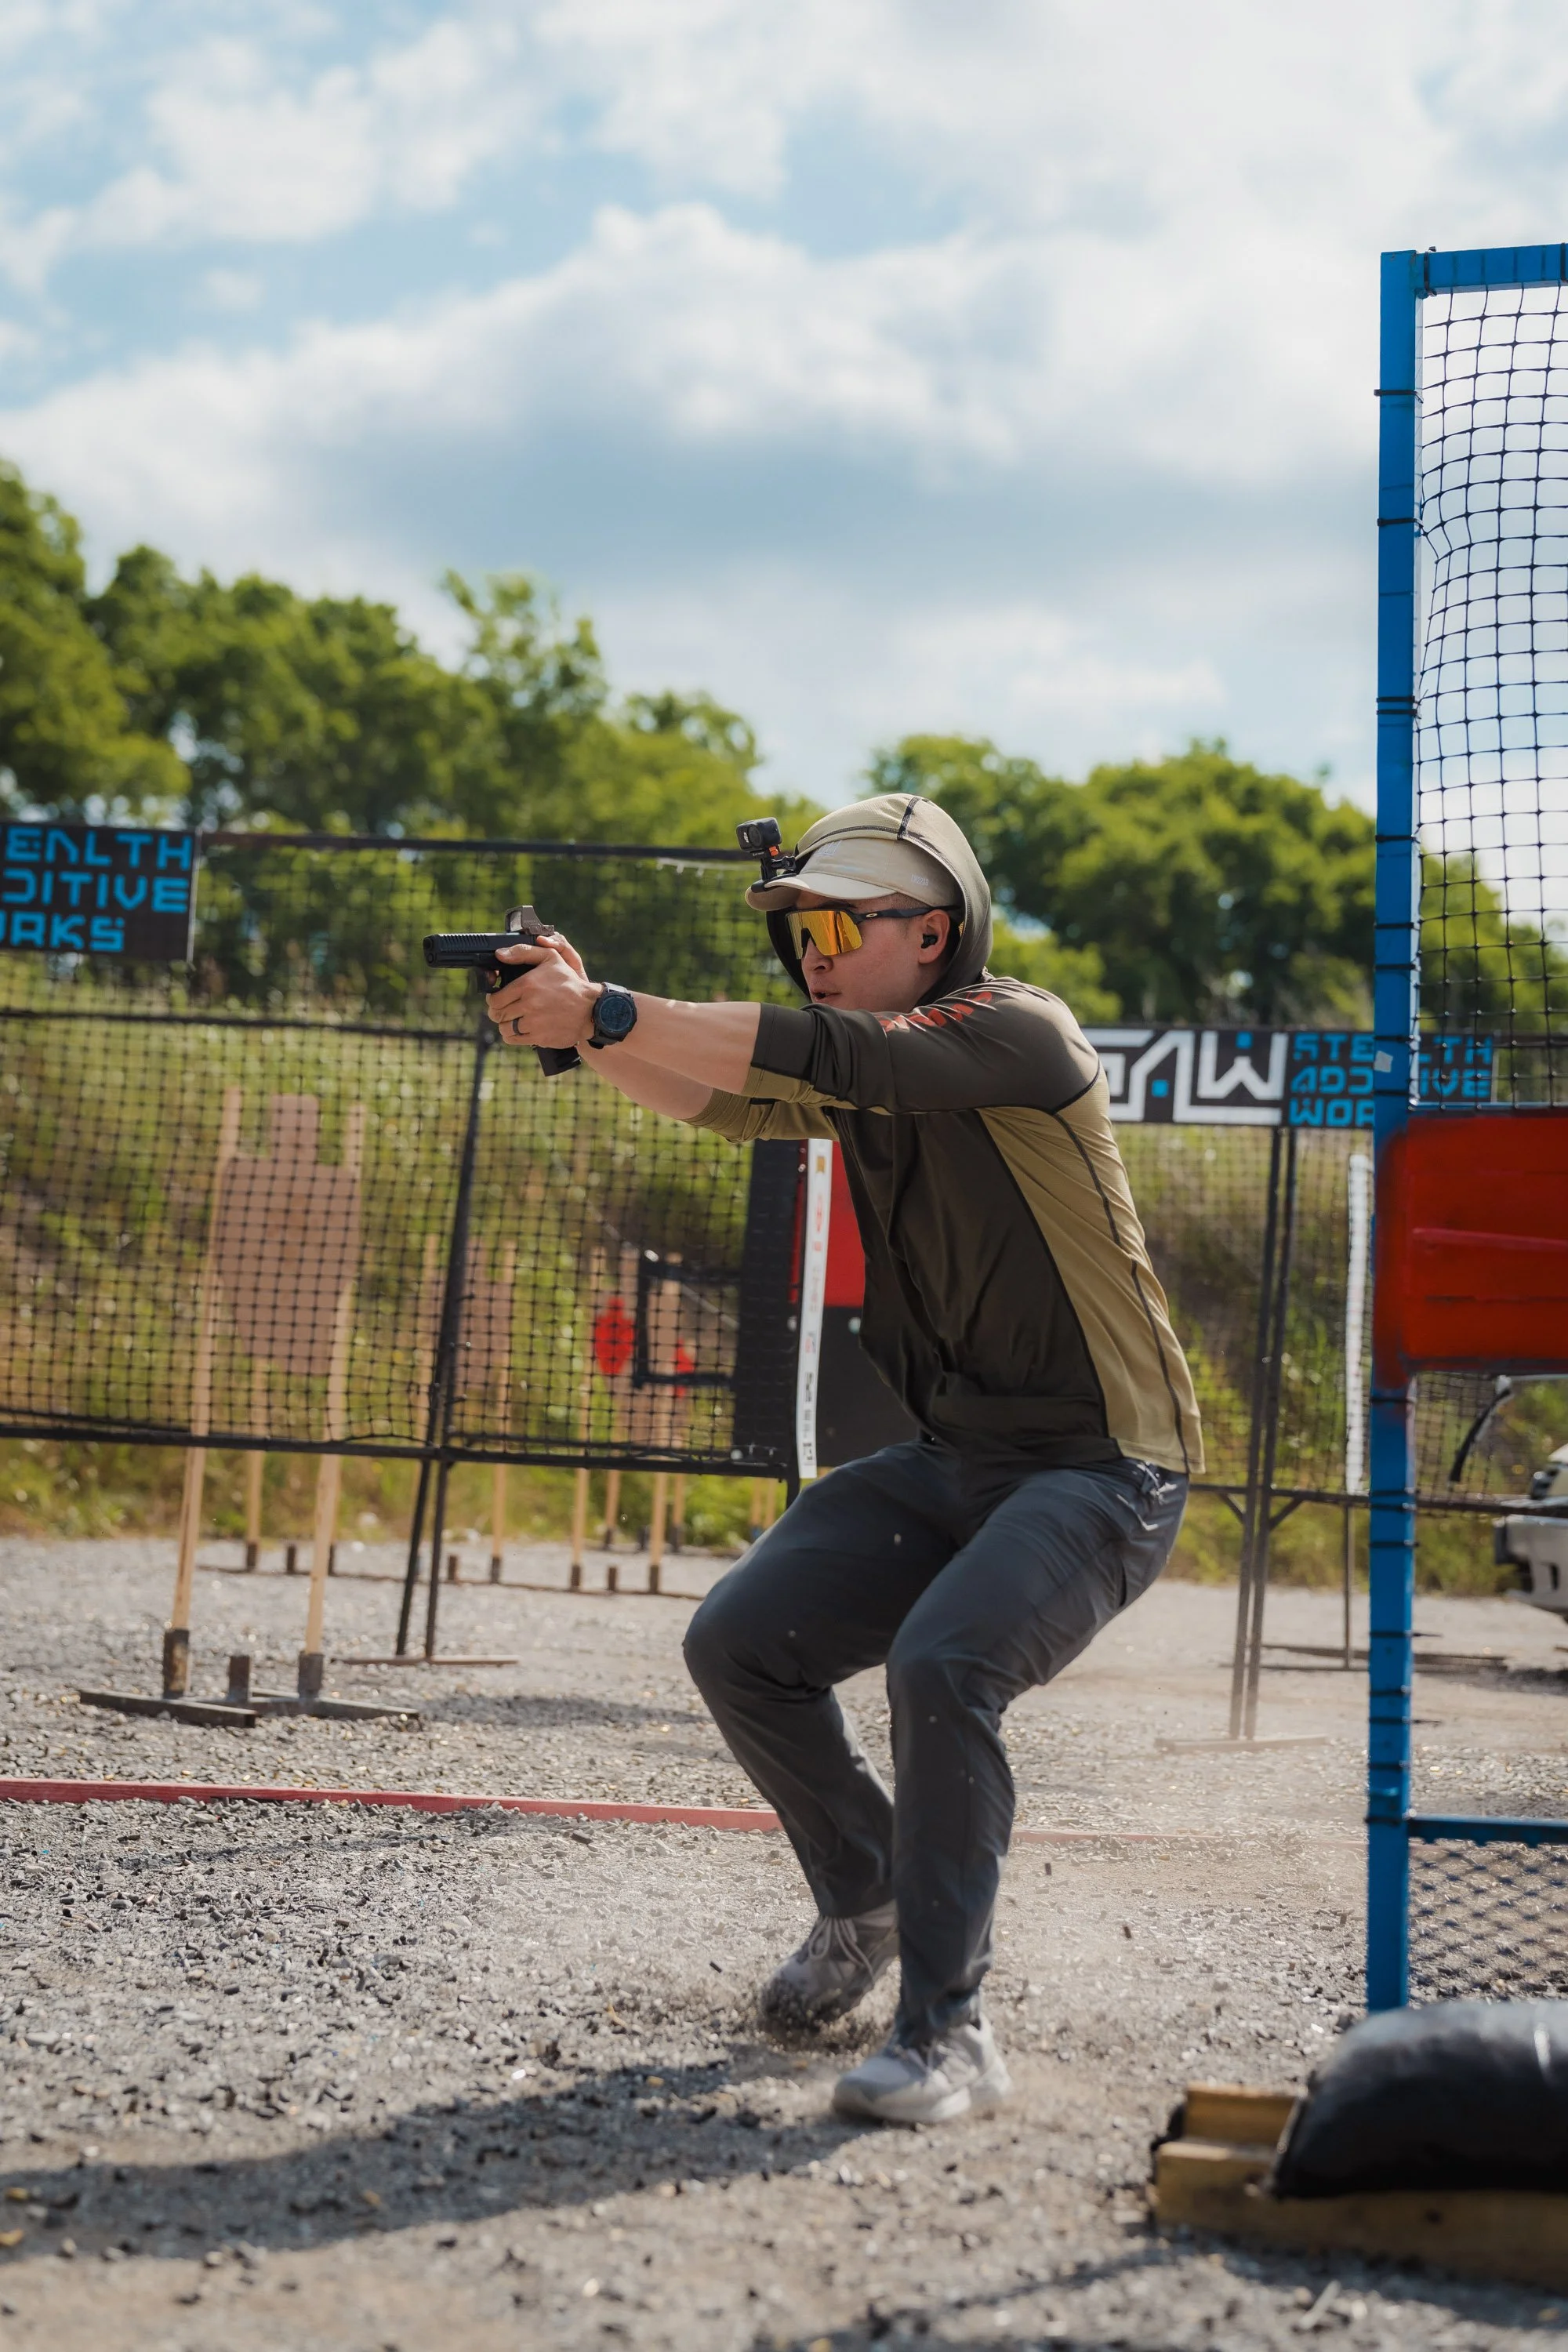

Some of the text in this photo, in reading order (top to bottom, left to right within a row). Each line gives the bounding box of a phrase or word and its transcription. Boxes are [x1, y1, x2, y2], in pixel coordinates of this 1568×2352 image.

[0, 826, 193, 871] EALTH
[0, 909, 125, 953] RKS
[1294, 1033, 1494, 1065] STETH
[1290, 1065, 1491, 1098] ADDIVE
[1288, 1098, 1374, 1127] WOR
